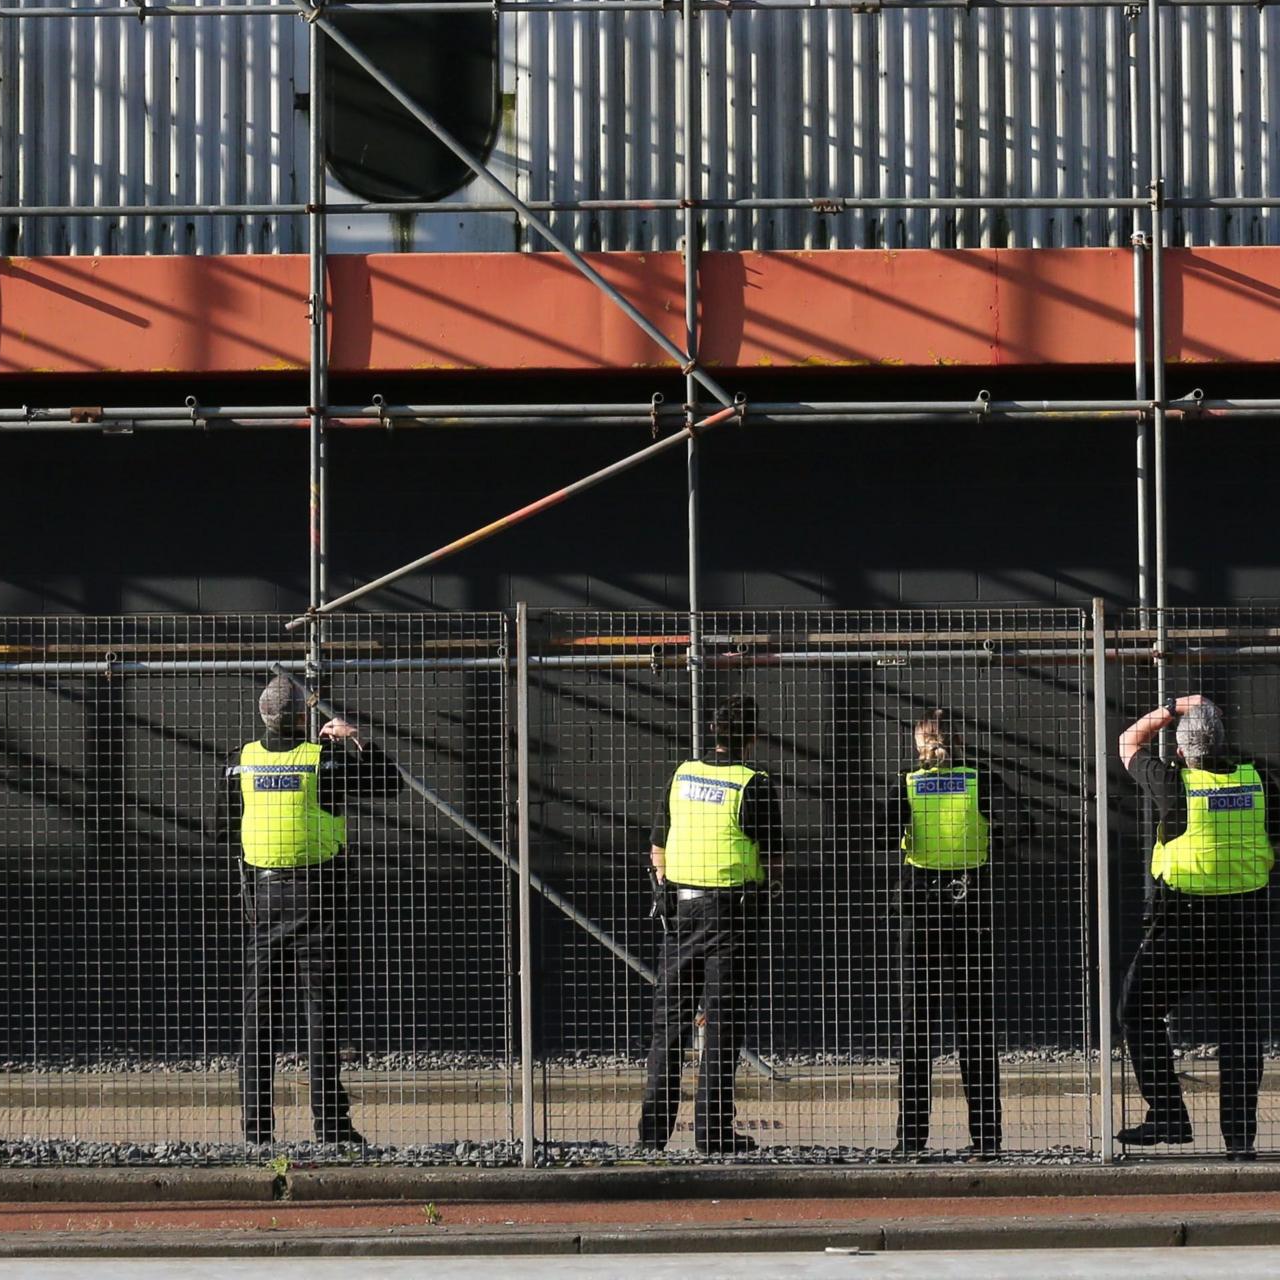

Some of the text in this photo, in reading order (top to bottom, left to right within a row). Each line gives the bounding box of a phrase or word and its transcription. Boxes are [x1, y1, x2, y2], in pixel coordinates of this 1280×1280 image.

[254, 775, 299, 790] POLICE
[917, 780, 965, 792] POLICE
[1210, 795, 1252, 809] POLICE
